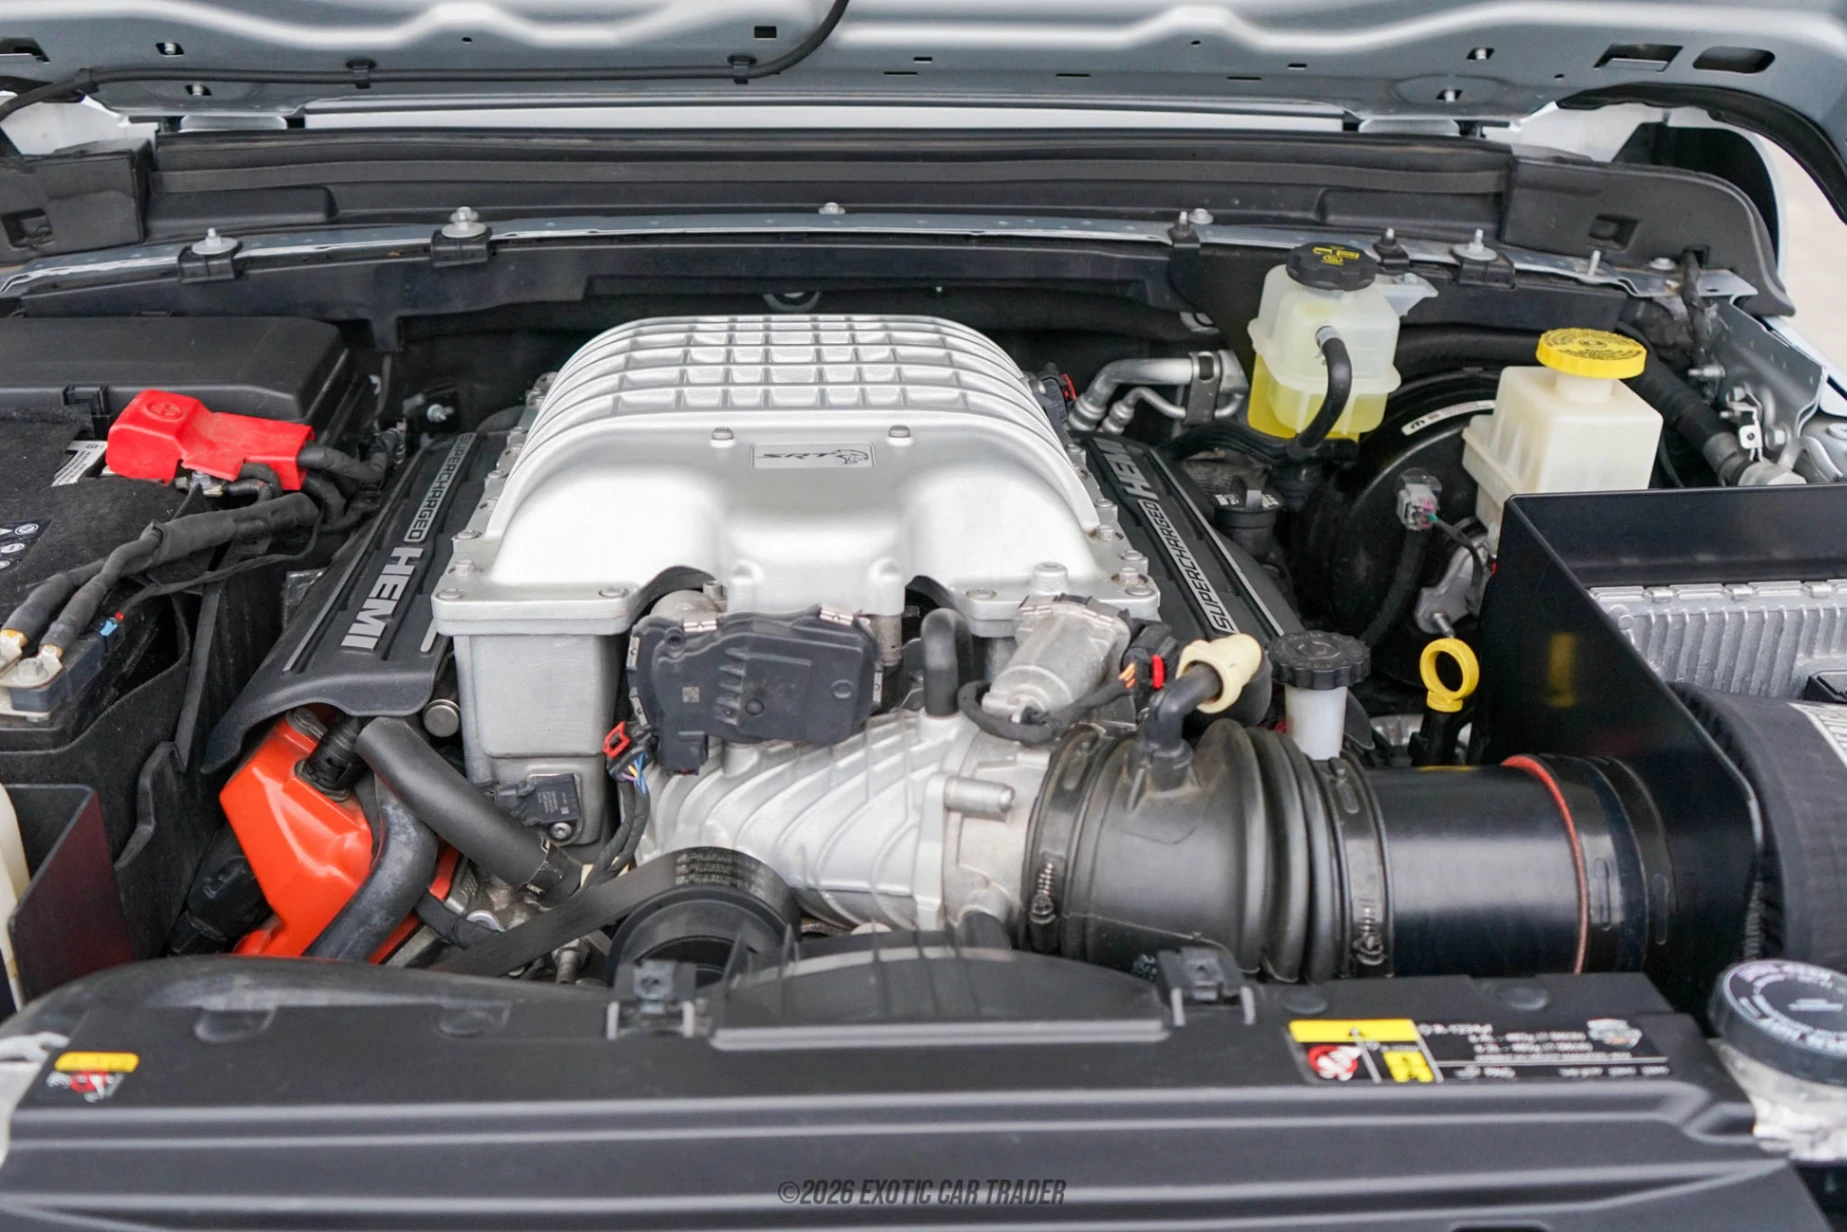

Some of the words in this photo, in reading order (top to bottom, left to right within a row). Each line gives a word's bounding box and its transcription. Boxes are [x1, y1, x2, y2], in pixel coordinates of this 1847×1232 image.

[407, 433, 474, 541] SUPERCHARGED
[756, 452, 833, 460] SRT
[340, 547, 424, 650] HEMI
[1141, 500, 1235, 632] SUPERCHARGED
